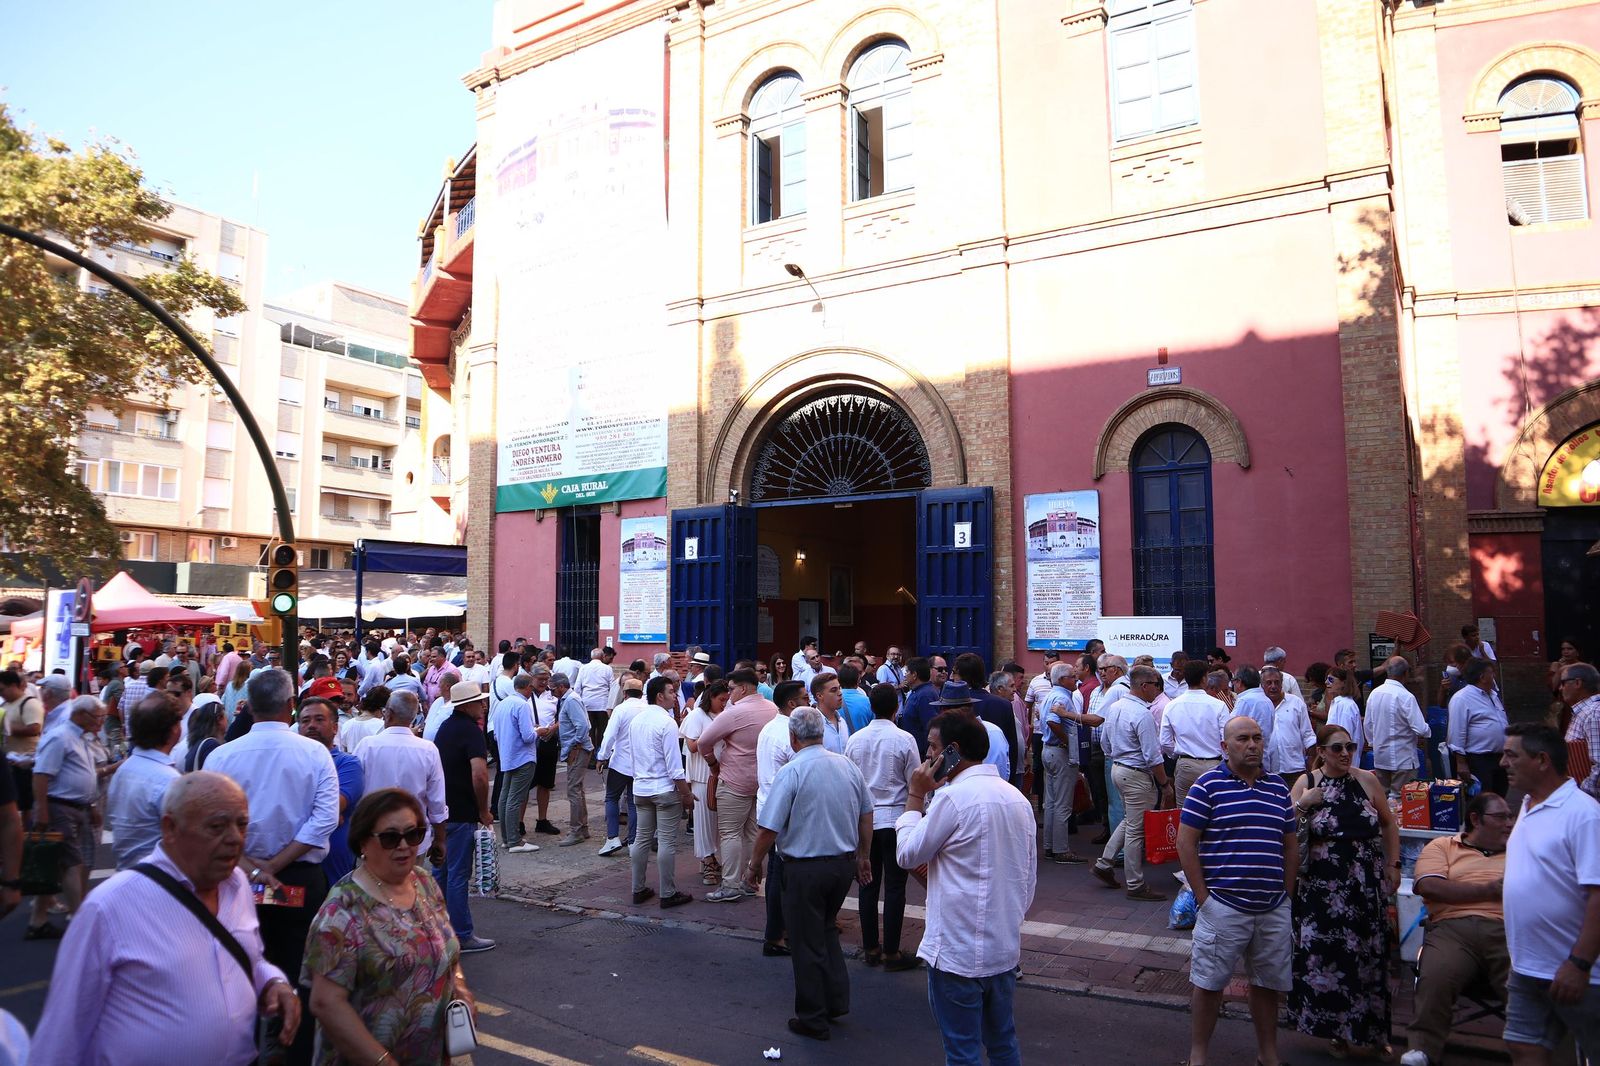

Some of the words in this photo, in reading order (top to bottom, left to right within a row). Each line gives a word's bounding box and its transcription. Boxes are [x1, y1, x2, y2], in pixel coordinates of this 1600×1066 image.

[512, 448, 530, 458] DIEGO
[531, 444, 561, 454] VENTURA
[511, 456, 535, 468] ANDRÉS
[536, 453, 562, 464] ROMERO
[1542, 466, 1560, 495] Asador
[1557, 454, 1567, 465] de
[561, 484, 580, 494] CAJA
[581, 481, 608, 491] RURAL
[958, 532, 966, 544] 3
[688, 546, 694, 556] 3
[1120, 633, 1169, 641] HERRADURA
